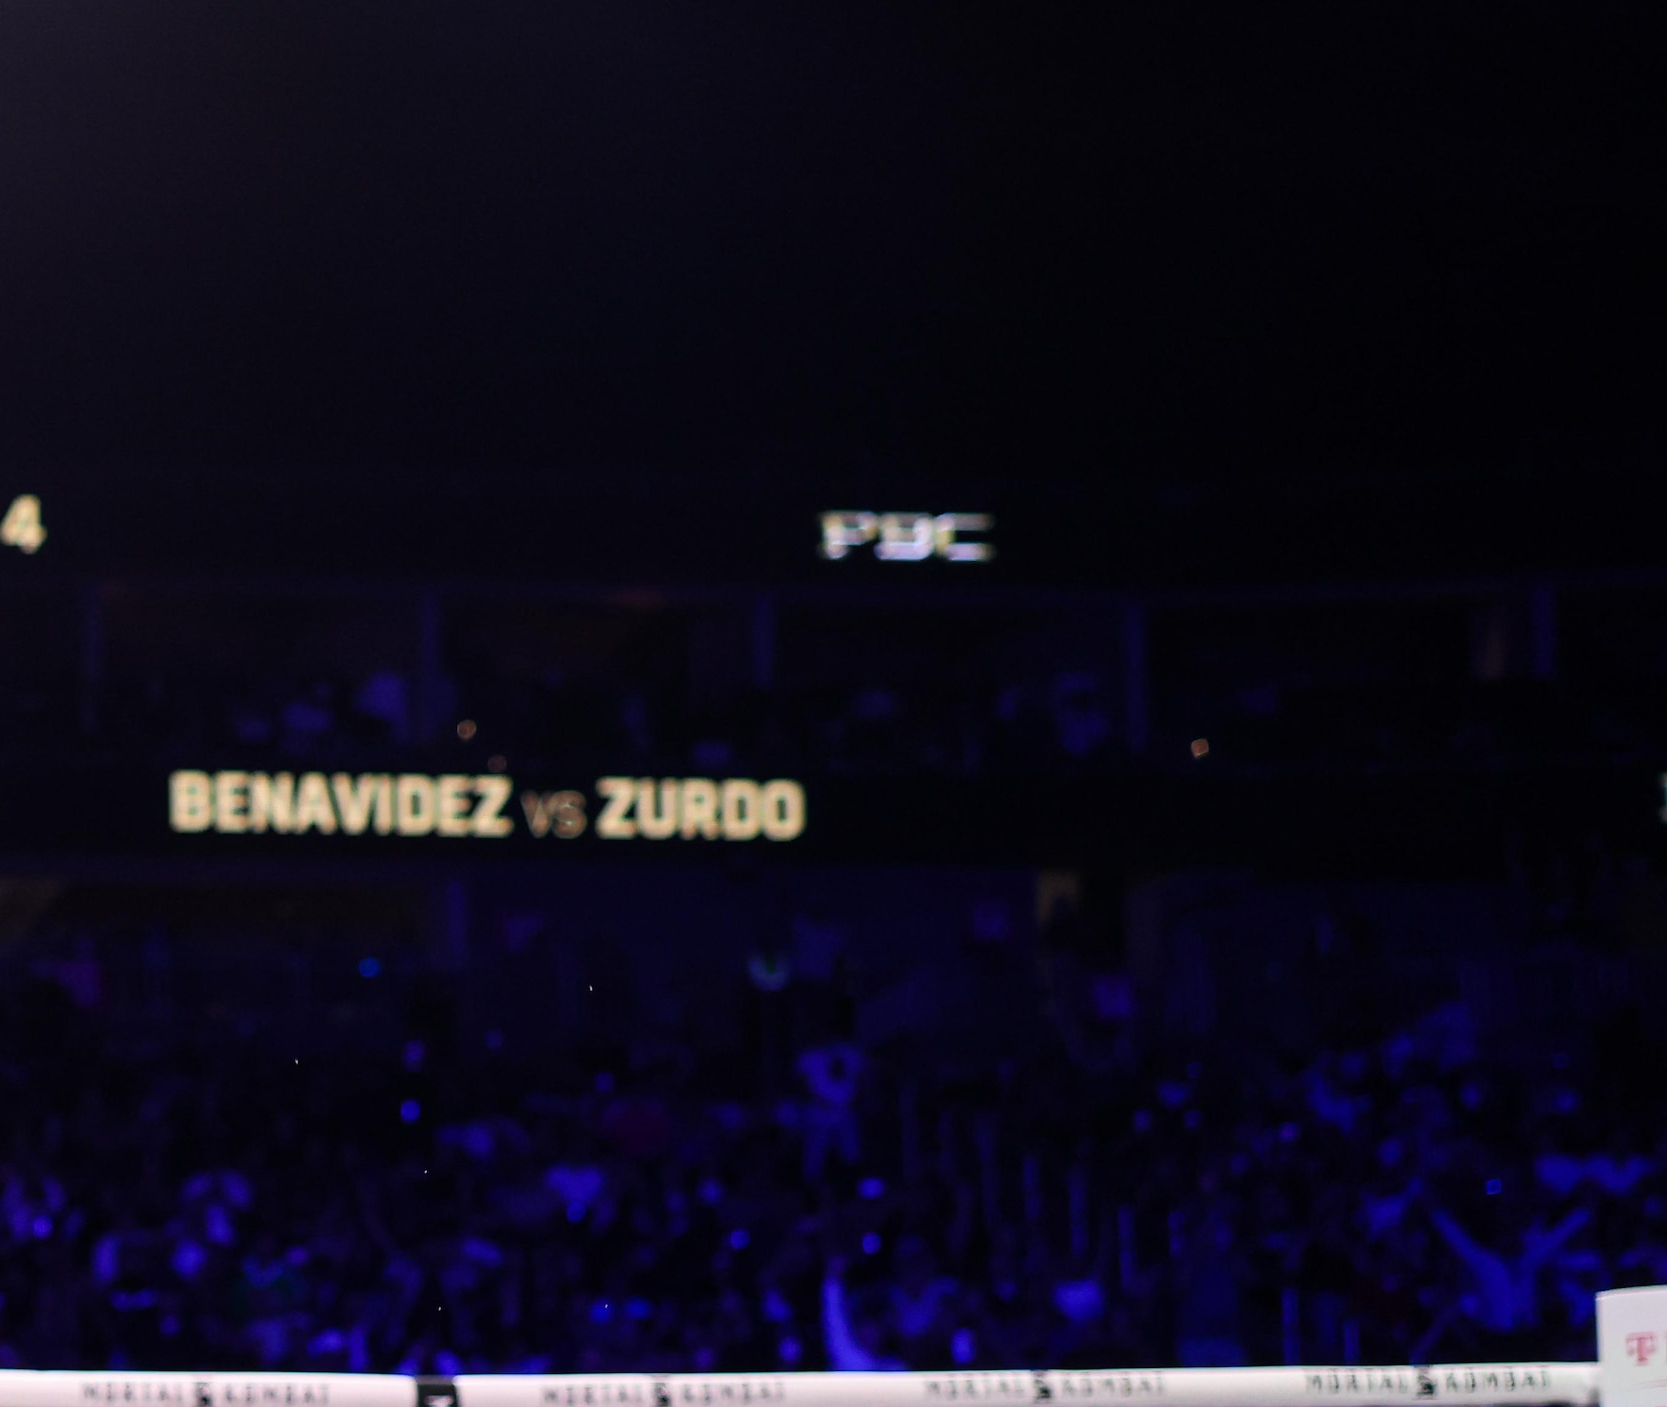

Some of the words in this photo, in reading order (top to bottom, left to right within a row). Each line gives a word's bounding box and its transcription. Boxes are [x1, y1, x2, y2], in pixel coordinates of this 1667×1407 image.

[0, 493, 45, 555] 4
[169, 770, 512, 838] BENAVIDEZ
[595, 776, 806, 841] ZURDO
